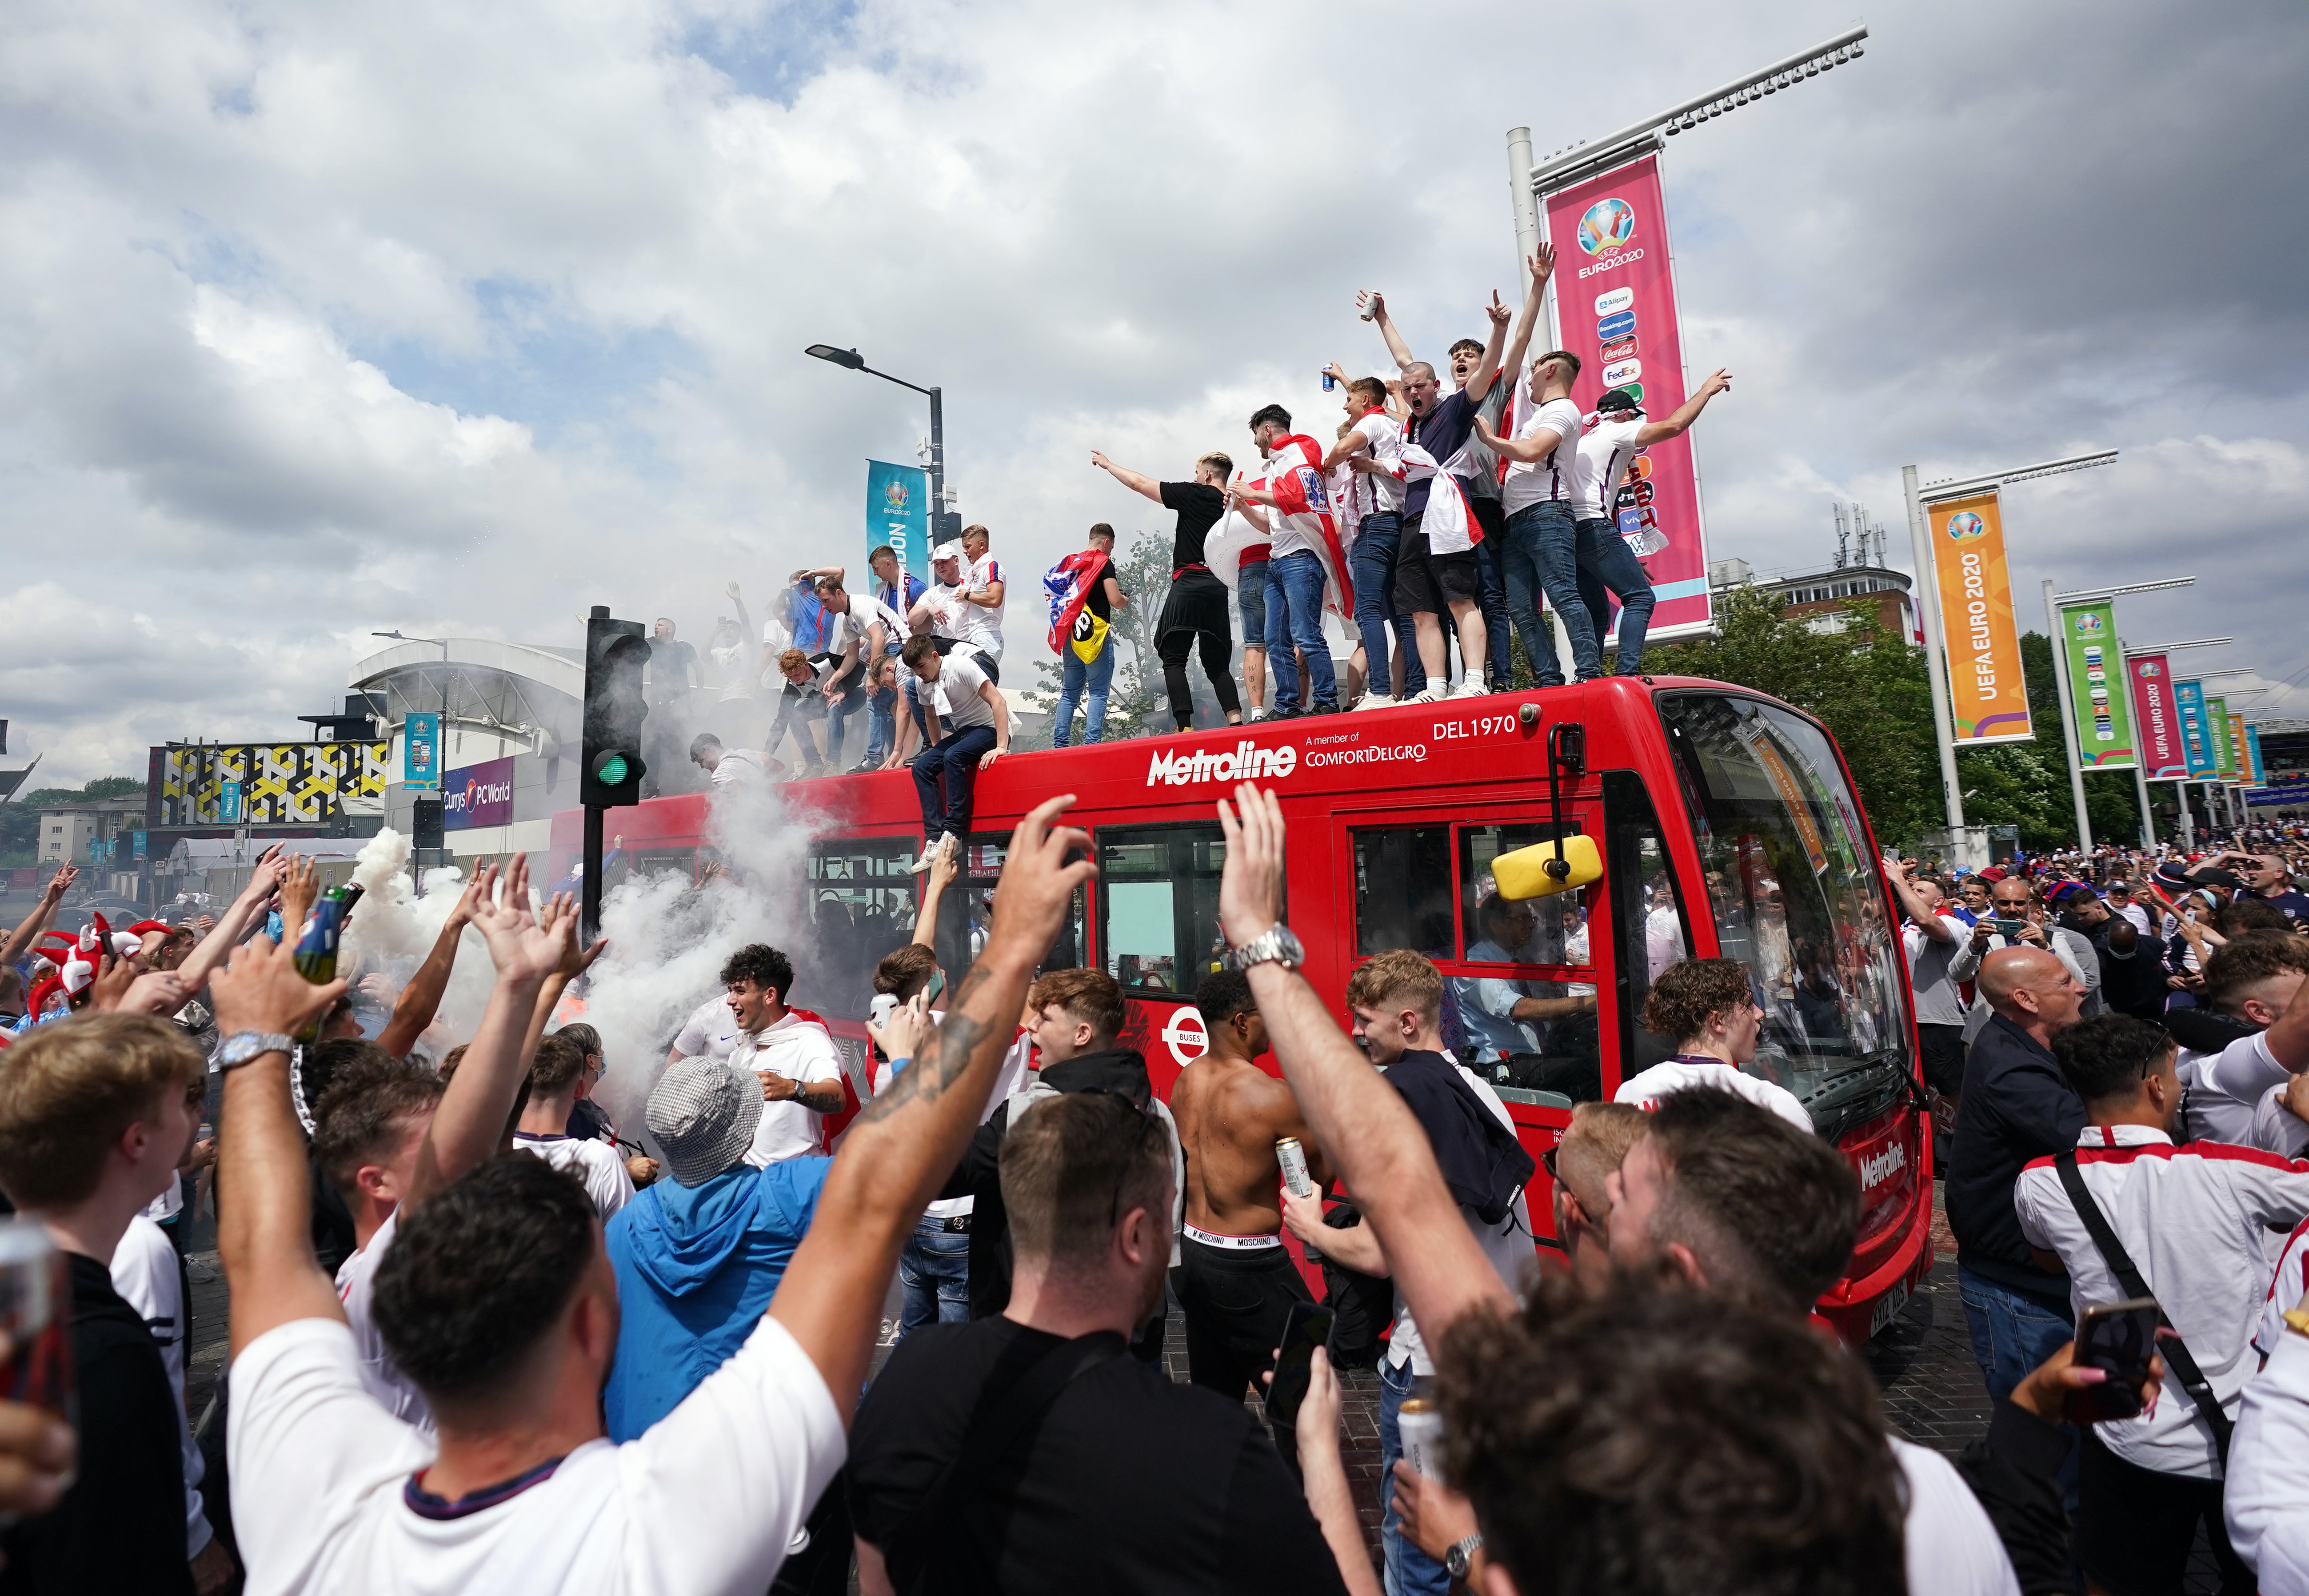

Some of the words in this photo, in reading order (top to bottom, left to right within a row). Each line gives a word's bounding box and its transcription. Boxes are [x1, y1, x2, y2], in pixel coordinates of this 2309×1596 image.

[1578, 248, 1644, 279] EURO2020
[1598, 248, 1618, 260] UEFA
[1608, 295, 1628, 306] Alipay
[1599, 318, 1634, 332] Booking.com
[1607, 367, 1636, 381] FedEx
[1961, 553, 1984, 598] 2020
[1969, 601, 1992, 650] EURO
[1979, 652, 1996, 700] UEFA
[2146, 683, 2162, 708] 2020
[1433, 722, 1468, 740] DEL
[1472, 715, 1516, 736] 1970
[2150, 708, 2166, 734] EURO
[1315, 733, 1348, 745] member
[1350, 731, 1359, 742] of
[2155, 734, 2170, 760] UEFA
[2213, 734, 2224, 752] EURO
[1147, 740, 1297, 787] Metroline
[2216, 752, 2226, 769] UEFA
[444, 790, 465, 812] Currys
[477, 785, 488, 805] PC
[488, 781, 510, 803] World
[1179, 1033, 1201, 1043] BUSES
[860, 1097, 871, 1105] MOVE
[1861, 1141, 1905, 1192] Metroline
[1198, 1233, 1224, 1245] MOSCHINO
[1238, 1237, 1270, 1246] MOSCHINO
